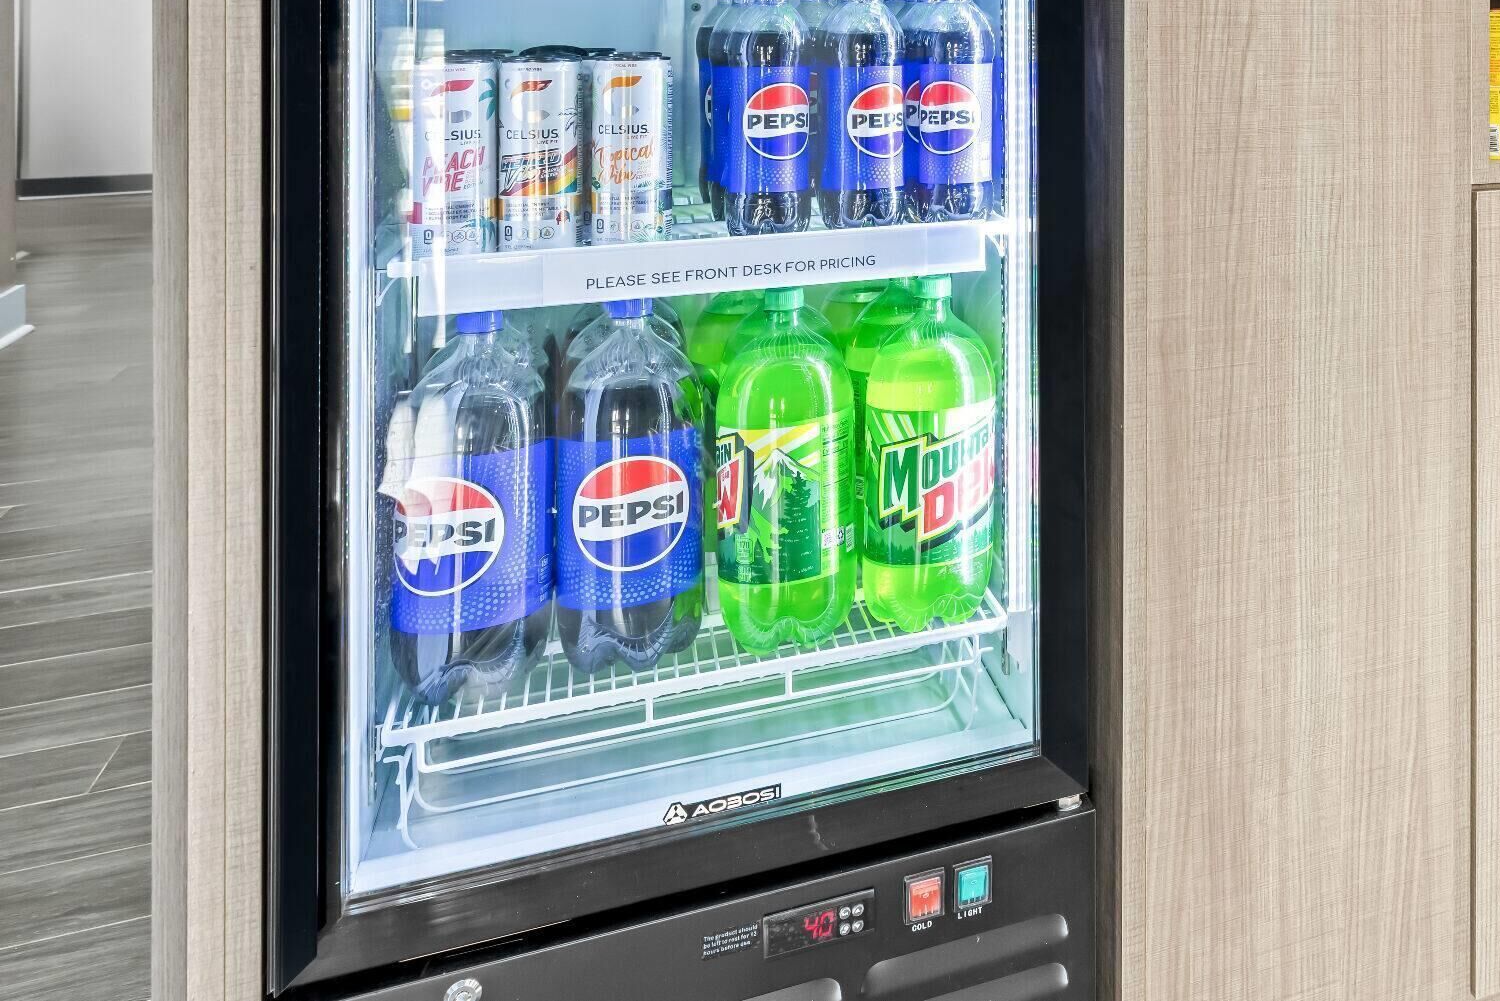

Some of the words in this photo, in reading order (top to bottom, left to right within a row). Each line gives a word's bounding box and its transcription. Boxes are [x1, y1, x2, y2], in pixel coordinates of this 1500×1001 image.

[747, 112, 809, 130] PEPSI
[852, 111, 903, 130] PEPS
[920, 108, 976, 125] PEPSI
[425, 129, 480, 140] CSIUS
[506, 129, 559, 140] CELSIUS
[599, 124, 649, 135] CELSIUS
[586, 273, 646, 290] PLEASE
[651, 270, 681, 285] SEE
[685, 266, 738, 281] FRONT
[743, 263, 782, 277] DESK
[786, 260, 816, 274] FOR
[820, 255, 876, 270] PRICING
[579, 490, 684, 528] PEPSI
[395, 517, 496, 546] PEPSI
[691, 784, 781, 818] AOBOSI
[957, 906, 983, 920] LIGHT
[715, 929, 737, 940] product
[738, 923, 758, 934] should
[803, 909, 835, 940] 40
[911, 920, 933, 932] COLD
[720, 943, 739, 952] before
